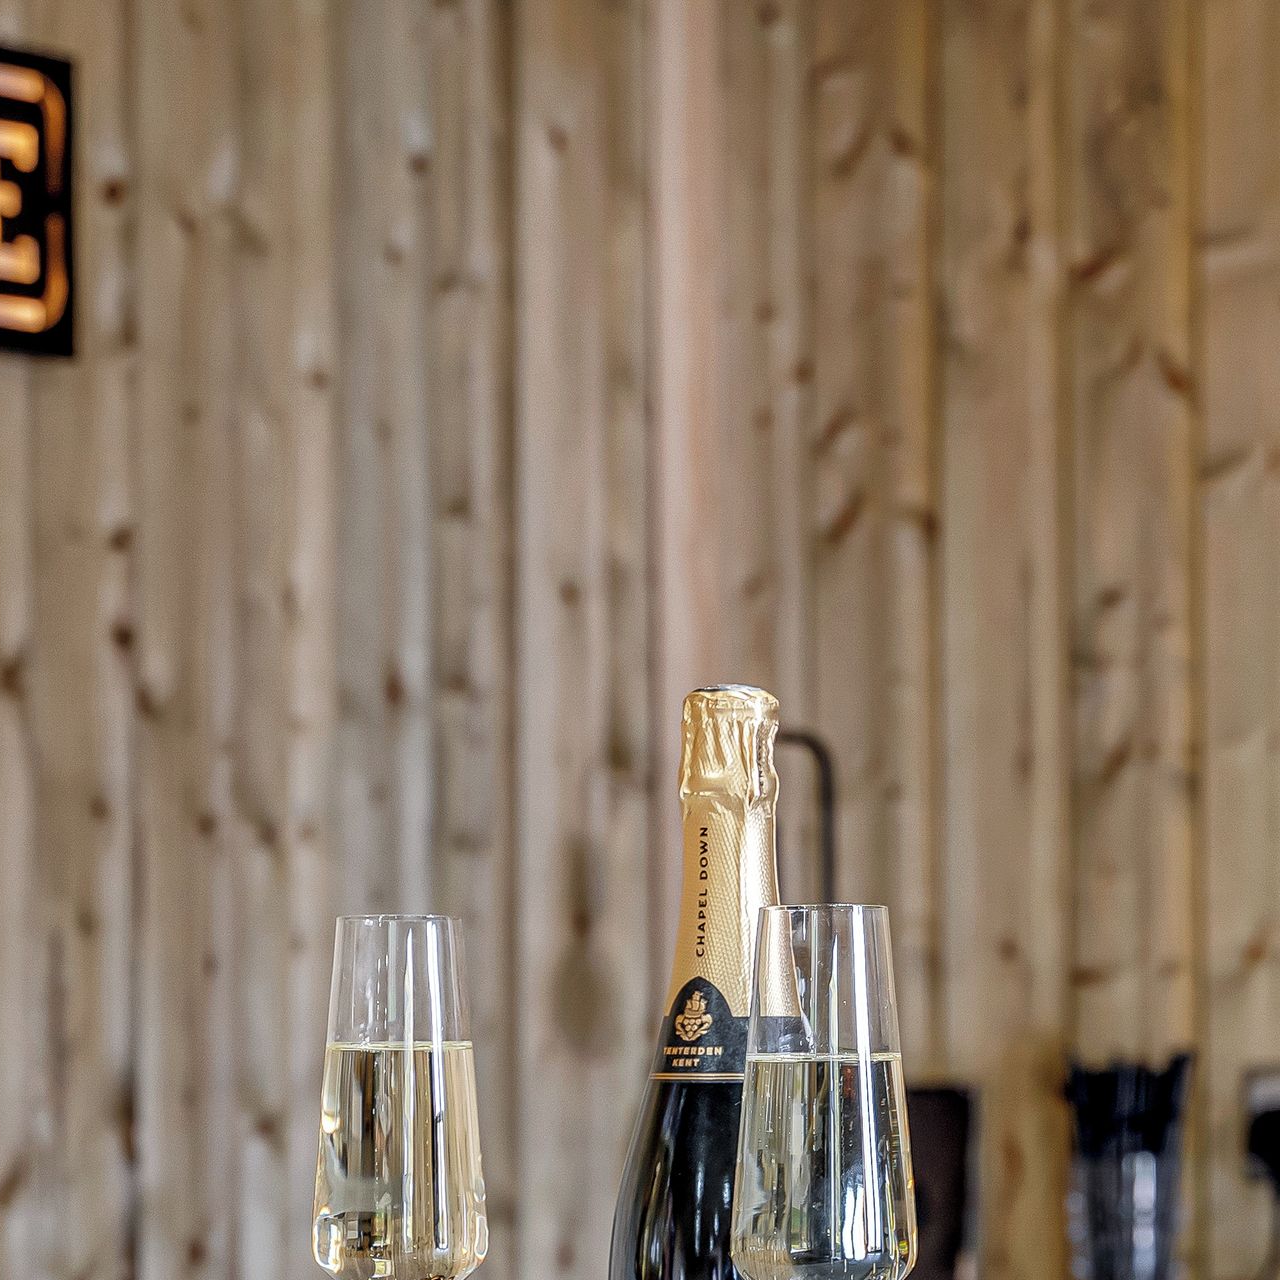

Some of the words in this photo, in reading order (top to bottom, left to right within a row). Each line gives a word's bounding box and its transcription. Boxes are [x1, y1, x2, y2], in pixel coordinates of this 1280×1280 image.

[699, 827, 709, 880] DOWN
[696, 888, 708, 957] CHAPEL
[663, 1046, 723, 1056] TENTERDEN
[671, 1058, 700, 1067] KENT
